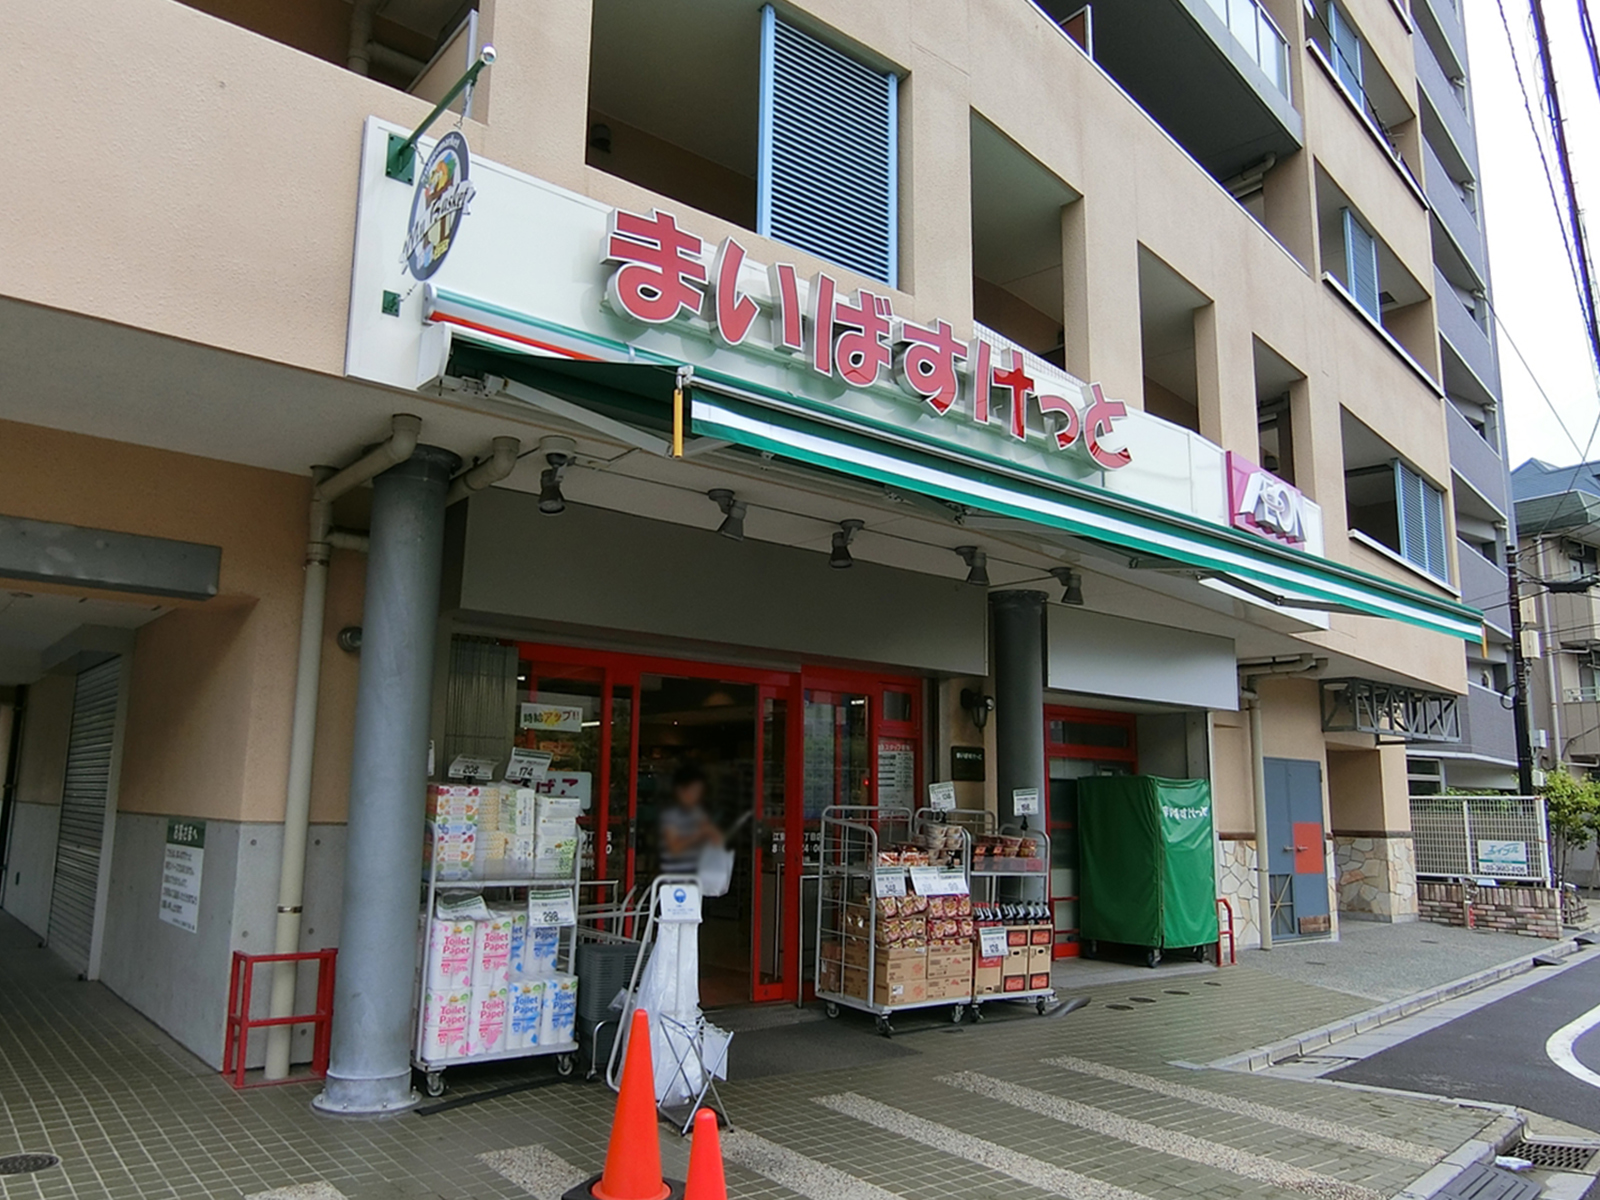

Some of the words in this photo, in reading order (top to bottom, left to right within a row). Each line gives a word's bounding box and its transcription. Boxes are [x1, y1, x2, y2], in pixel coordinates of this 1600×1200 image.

[602, 207, 1132, 471] まいばすけっと
[444, 936, 470, 945] Toilet
[484, 933, 509, 941] Toilet
[442, 945, 470, 955] Paper
[483, 942, 509, 952] Paper
[515, 996, 538, 1004] Toilet
[481, 1001, 505, 1010] Toilet
[513, 1004, 539, 1014] Paper
[440, 1006, 466, 1015] Toilet
[480, 1010, 505, 1019] Paper
[439, 1015, 467, 1026] Paper
